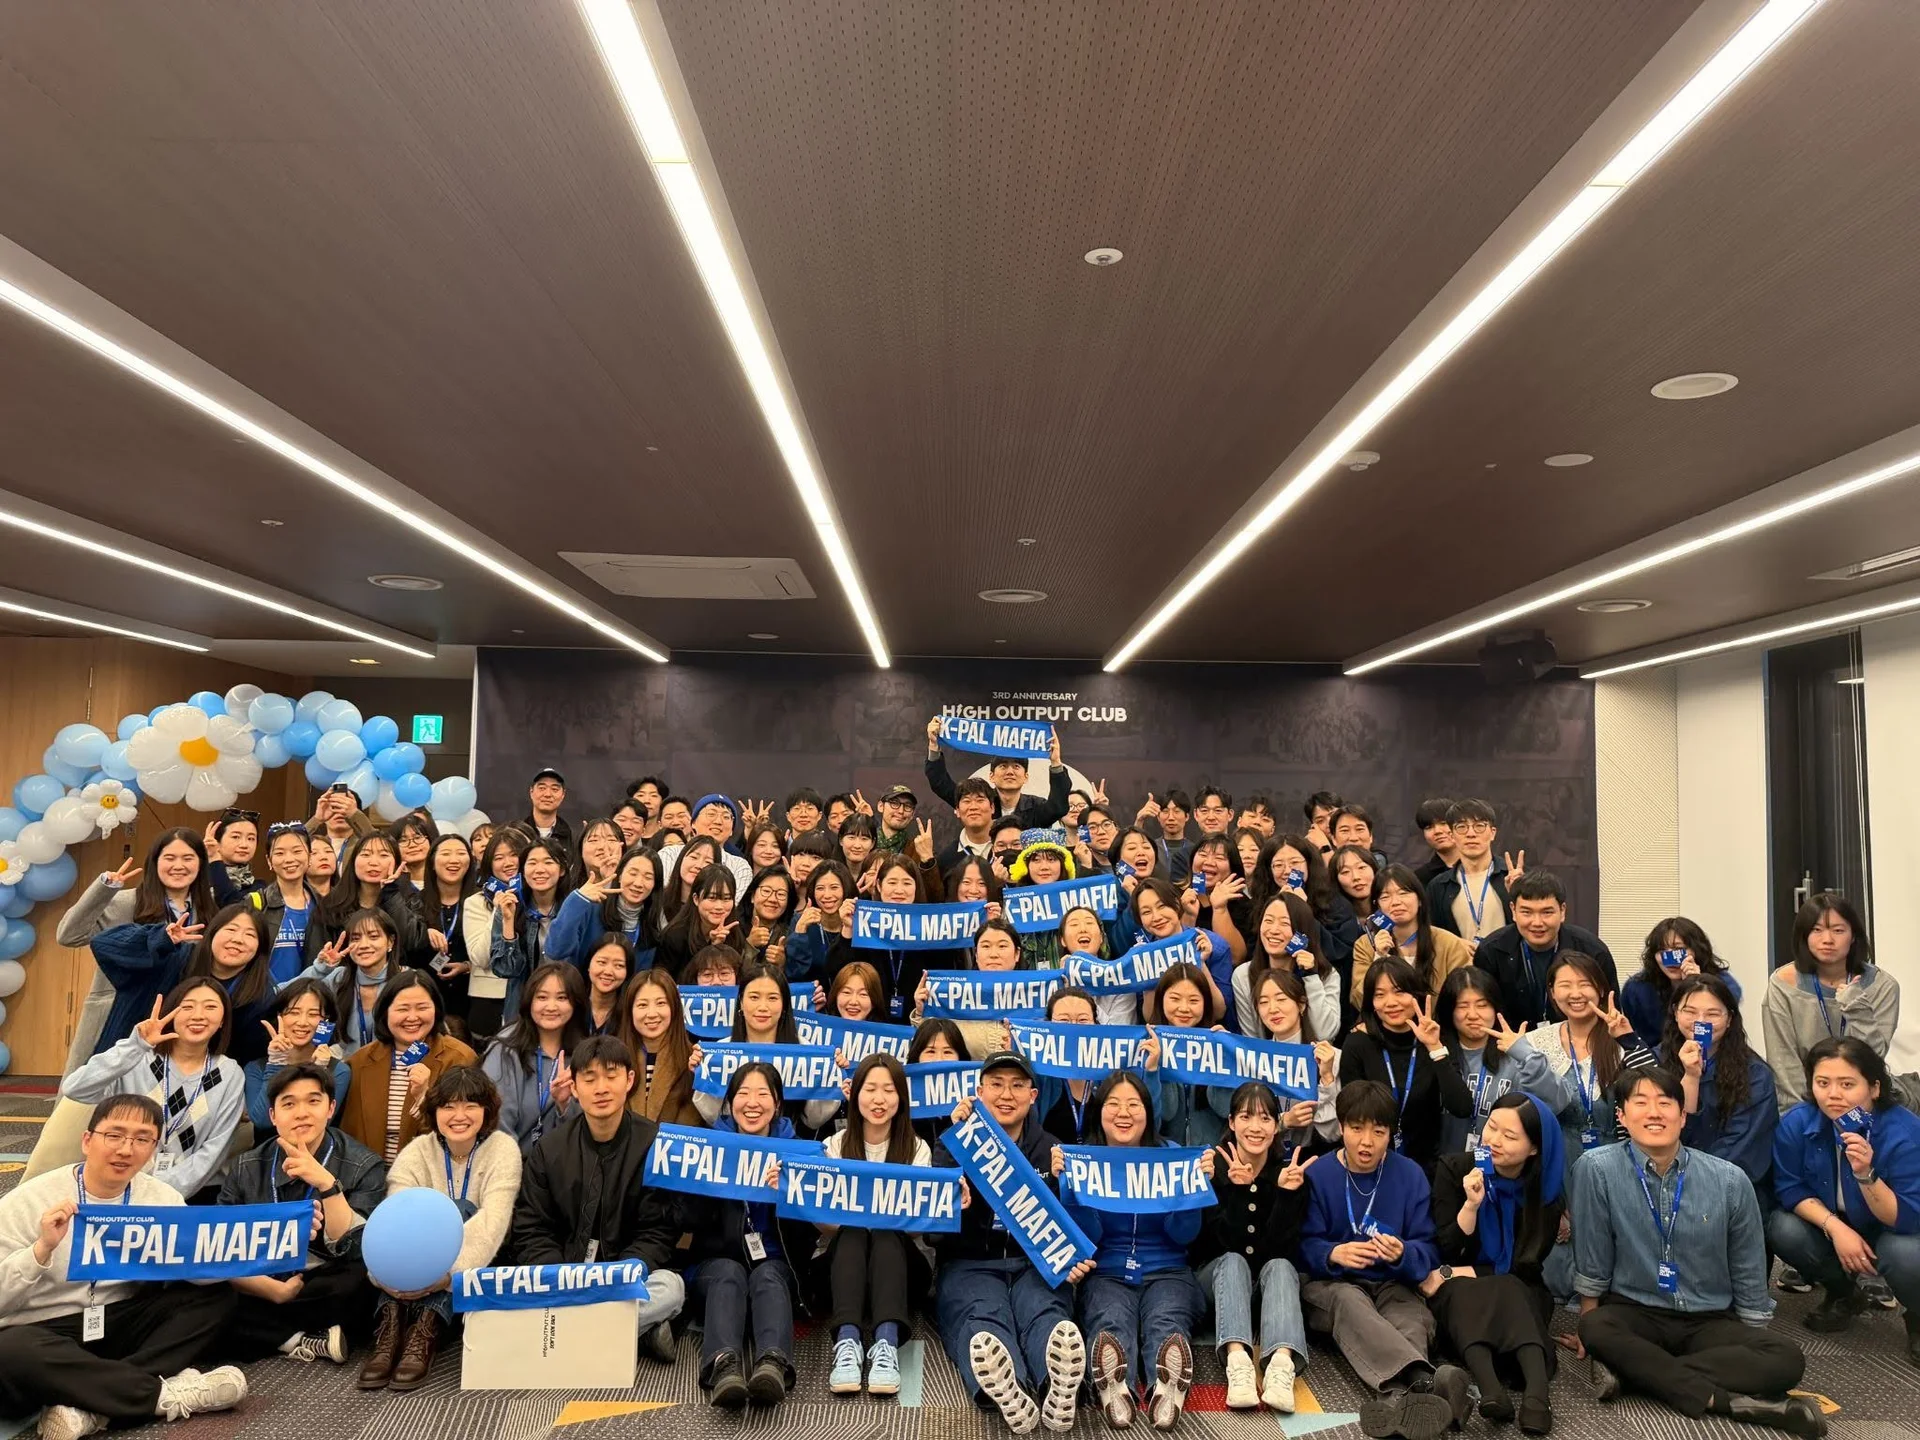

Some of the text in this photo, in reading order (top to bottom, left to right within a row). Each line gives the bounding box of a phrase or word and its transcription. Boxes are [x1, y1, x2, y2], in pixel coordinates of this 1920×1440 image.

[992, 691, 1078, 700] 3RD ANNIVERSARY
[942, 704, 1127, 722] HIGH OUTPUT CLUB
[939, 717, 1047, 752] K-PAL MAFIA
[1059, 884, 1118, 915] MAFIA
[858, 910, 980, 940] K-PAL MAFIA
[1068, 960, 1132, 987] K-PAL
[926, 980, 1058, 1010] K-PAL MAFIA
[842, 1030, 910, 1066] MAFIA
[1078, 1036, 1146, 1070] MAFIA
[1162, 1038, 1310, 1089] K-PAL MAFIA
[772, 1056, 842, 1088] MAFIA
[924, 1068, 981, 1106] MAFI
[652, 1138, 729, 1184] K-PAL
[786, 1168, 954, 1218] K-PAL MAFIA
[954, 1112, 1076, 1275] K-PAL MAFIA
[1126, 1158, 1208, 1199] MAFIA
[81, 1220, 298, 1266] K-PAL MAFIA
[462, 1264, 642, 1297] K-PAL MAFIA
